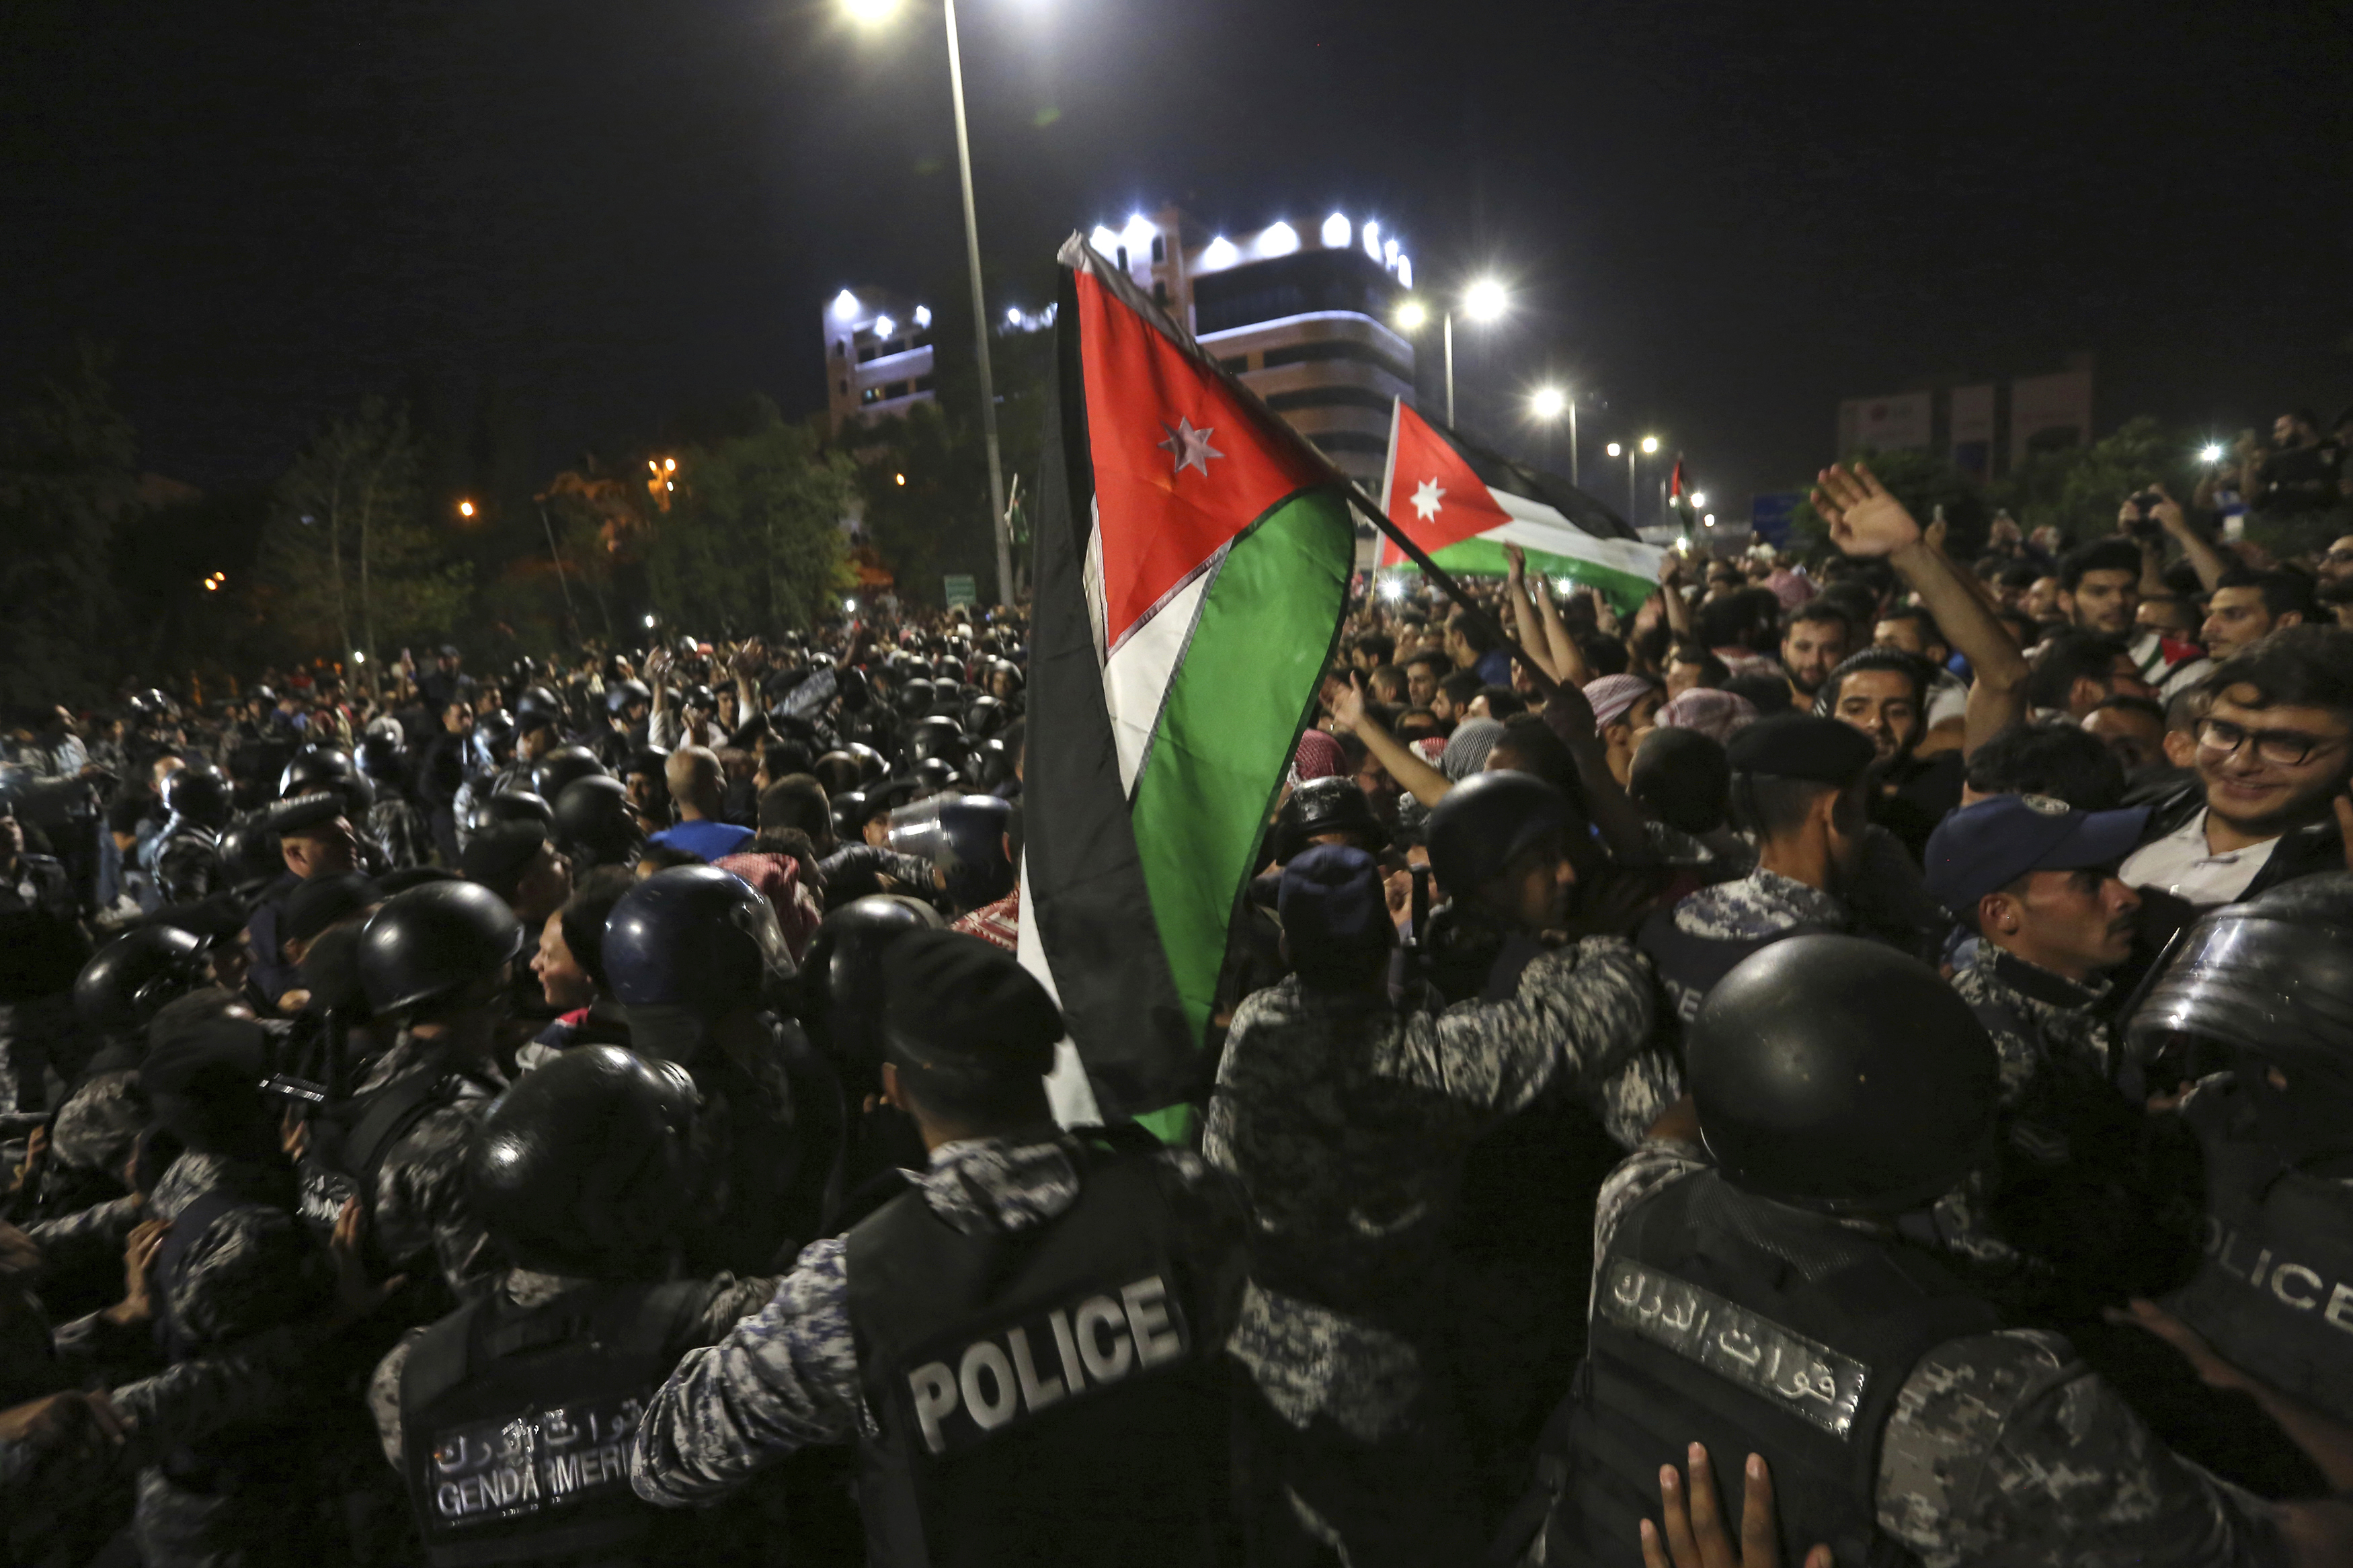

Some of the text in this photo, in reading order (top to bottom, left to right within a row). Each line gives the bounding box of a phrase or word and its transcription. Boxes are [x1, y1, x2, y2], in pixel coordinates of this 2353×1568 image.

[2202, 1215, 2353, 1335] OLICE
[908, 1274, 1183, 1454] POLICE
[437, 1441, 631, 1516] GENDARMERI
